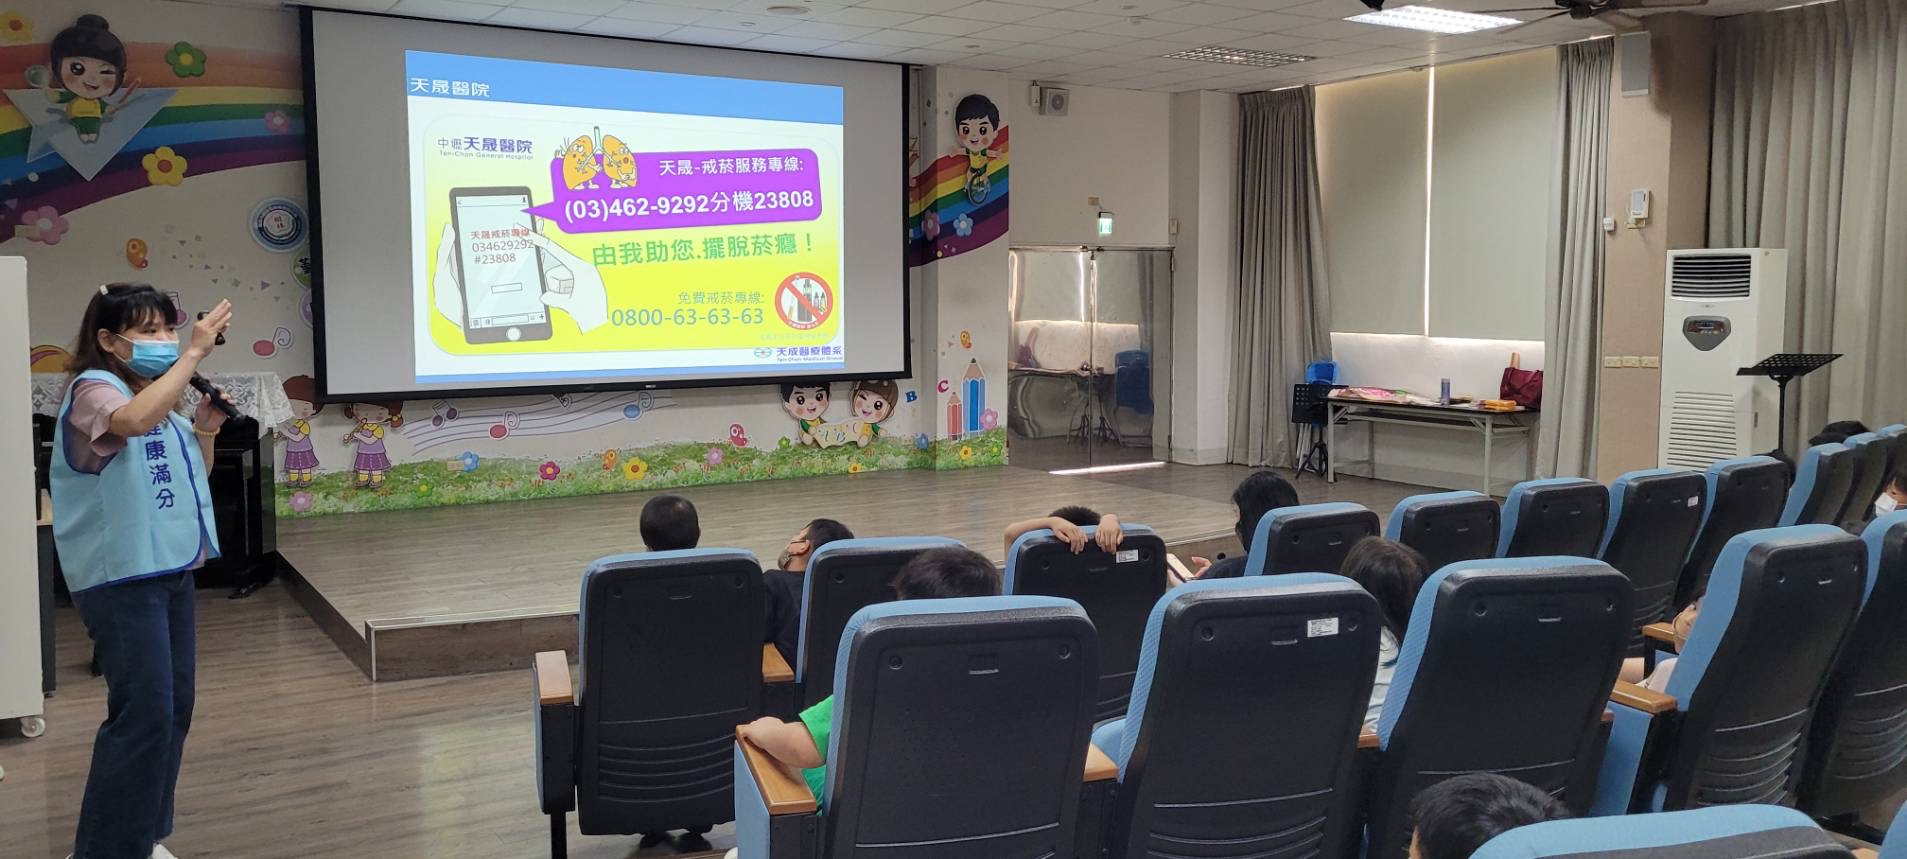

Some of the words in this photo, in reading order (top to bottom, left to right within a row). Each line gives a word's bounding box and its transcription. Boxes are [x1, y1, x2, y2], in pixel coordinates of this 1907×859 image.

[411, 78, 490, 97] 天晟醫院
[659, 157, 804, 176] 天晟-戒菸服務專線:
[564, 190, 814, 224] (03)462-9292分機23808
[472, 240, 533, 252] 034629292
[475, 253, 516, 264] #23808
[611, 308, 764, 326] 0800-63-63-63
[937, 380, 949, 393] C
